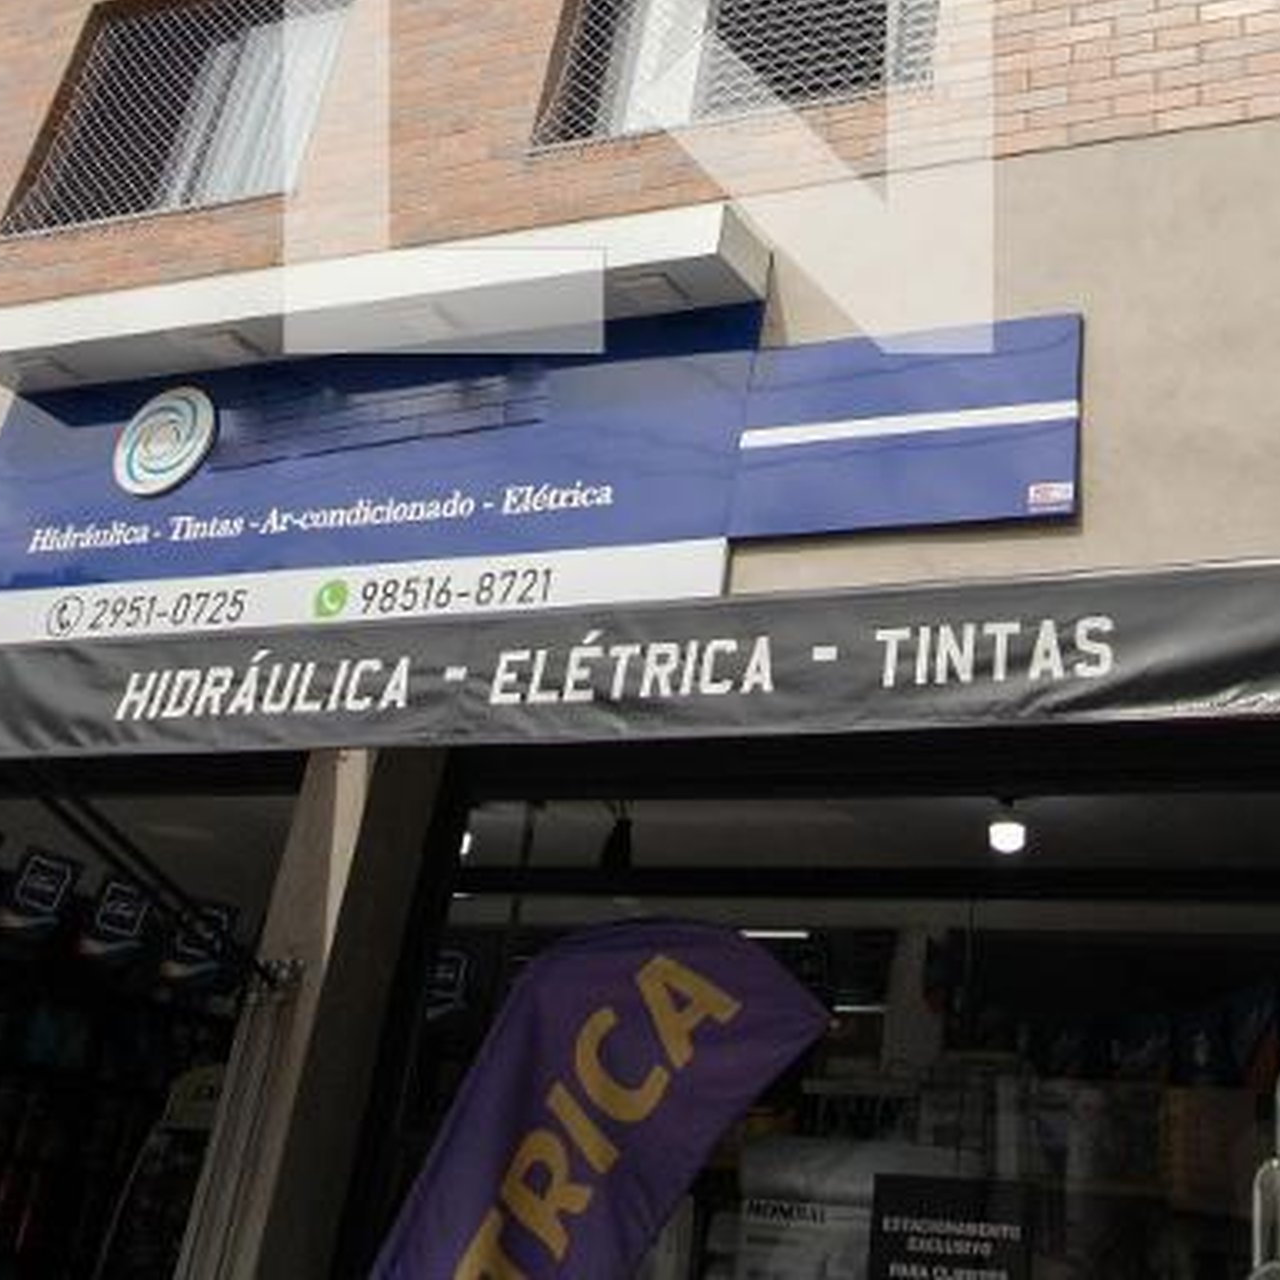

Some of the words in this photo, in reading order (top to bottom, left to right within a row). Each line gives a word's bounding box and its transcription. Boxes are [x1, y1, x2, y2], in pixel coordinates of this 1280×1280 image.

[28, 521, 151, 553] Hidráulica
[170, 513, 245, 542] Tintas
[501, 480, 614, 515] Elétrica
[88, 588, 248, 630] 2951-0725
[360, 569, 554, 614] 98516-8721
[115, 649, 412, 721] HIDRÁULICA
[489, 629, 774, 705] ELÉTRICA
[875, 615, 1115, 688] TINTAS
